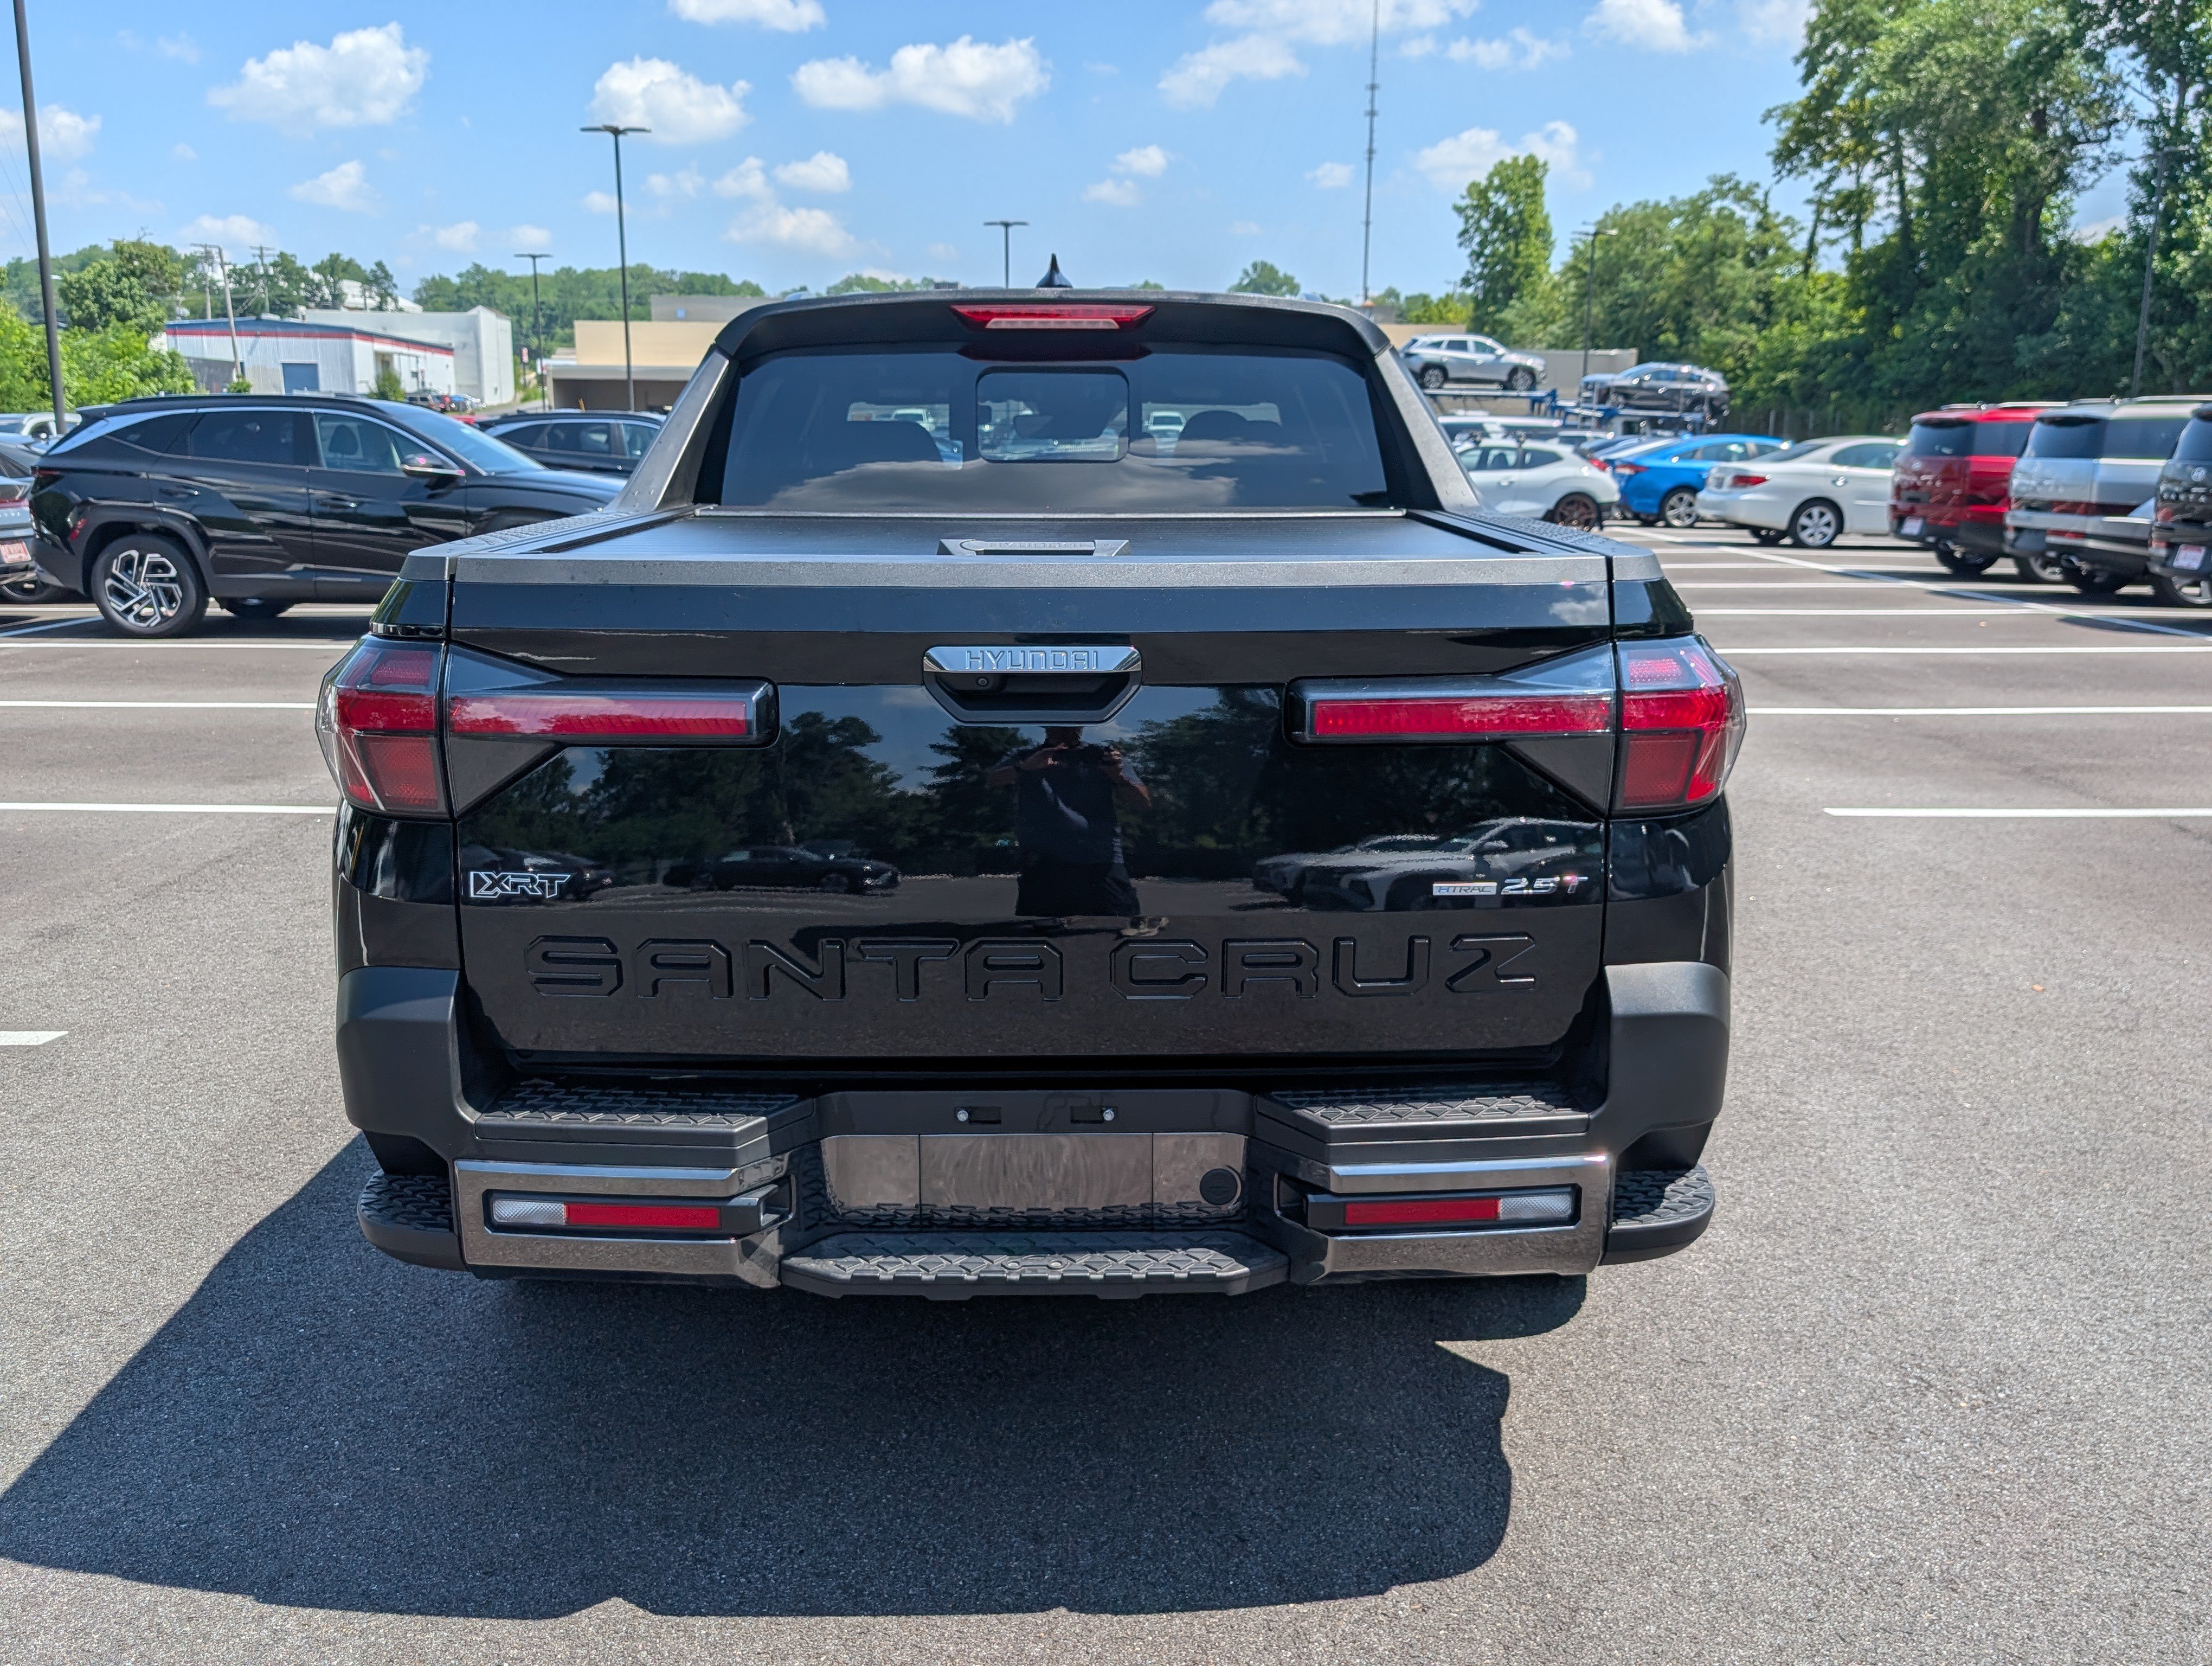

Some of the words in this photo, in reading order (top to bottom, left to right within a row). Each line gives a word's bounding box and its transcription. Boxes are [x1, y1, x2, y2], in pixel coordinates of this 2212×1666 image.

[965, 650, 1098, 670] HYUNDAI
[470, 871, 572, 899] XRT
[1437, 885, 1492, 894] HTRAC
[526, 935, 1063, 1002] SANTA
[1110, 932, 1536, 1001] CRUZ
